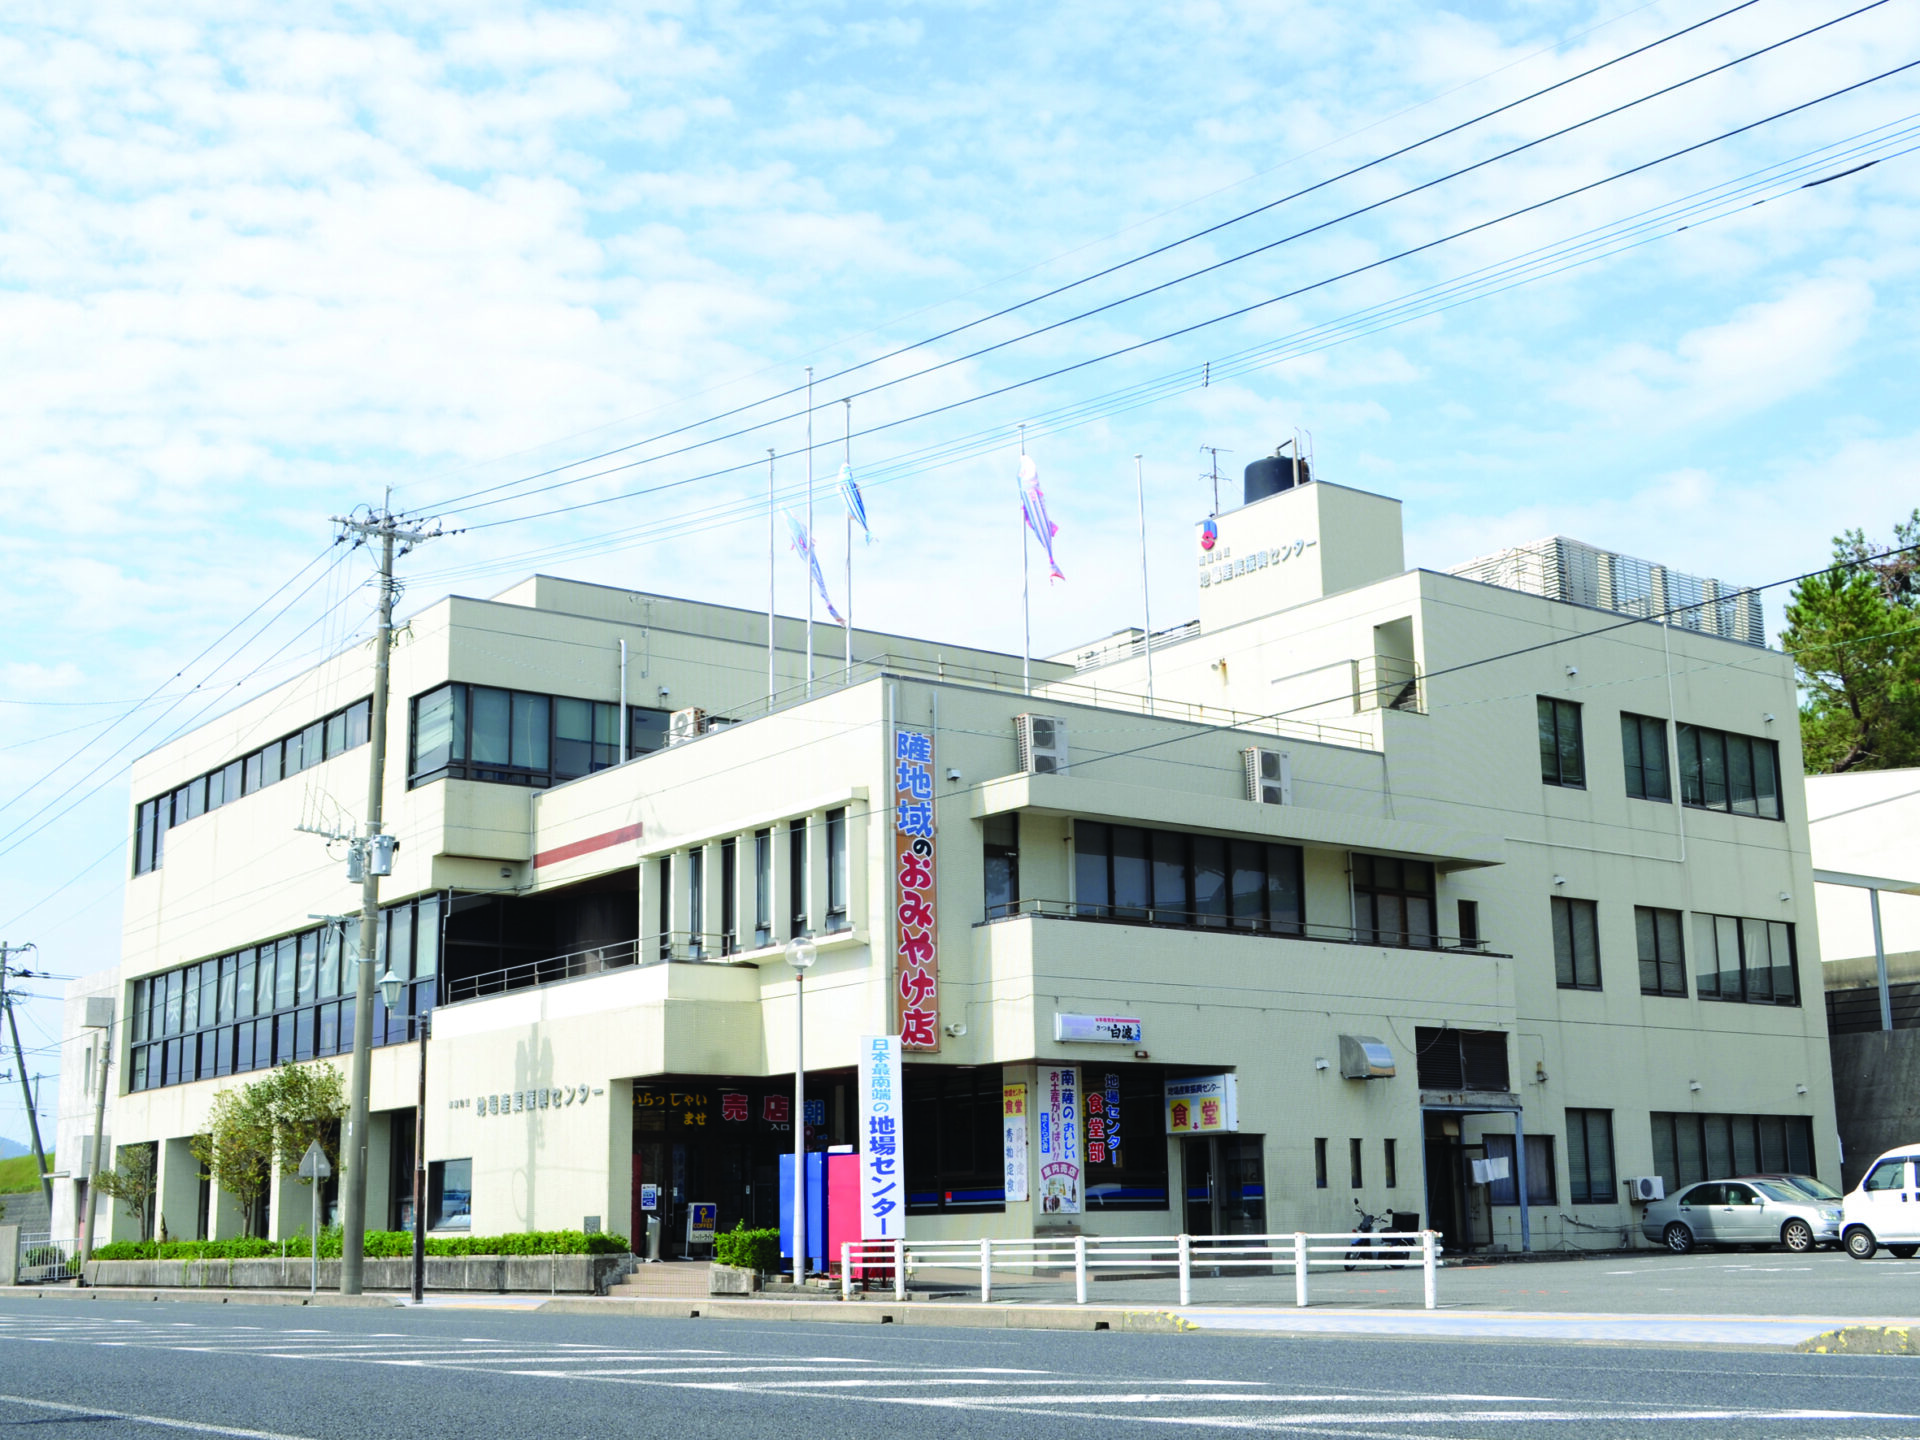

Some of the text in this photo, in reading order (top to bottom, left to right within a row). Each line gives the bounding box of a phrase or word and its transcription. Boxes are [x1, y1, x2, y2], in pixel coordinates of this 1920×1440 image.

[683, 1111, 708, 1126] ませ
[722, 1093, 790, 1122] 売店
[1005, 1099, 1023, 1114] 食堂
[1105, 1073, 1121, 1165] 地場センター
[1172, 1101, 1218, 1128] 食堂
[770, 1123, 790, 1131] 入口
[1088, 1093, 1106, 1163] 食堂部
